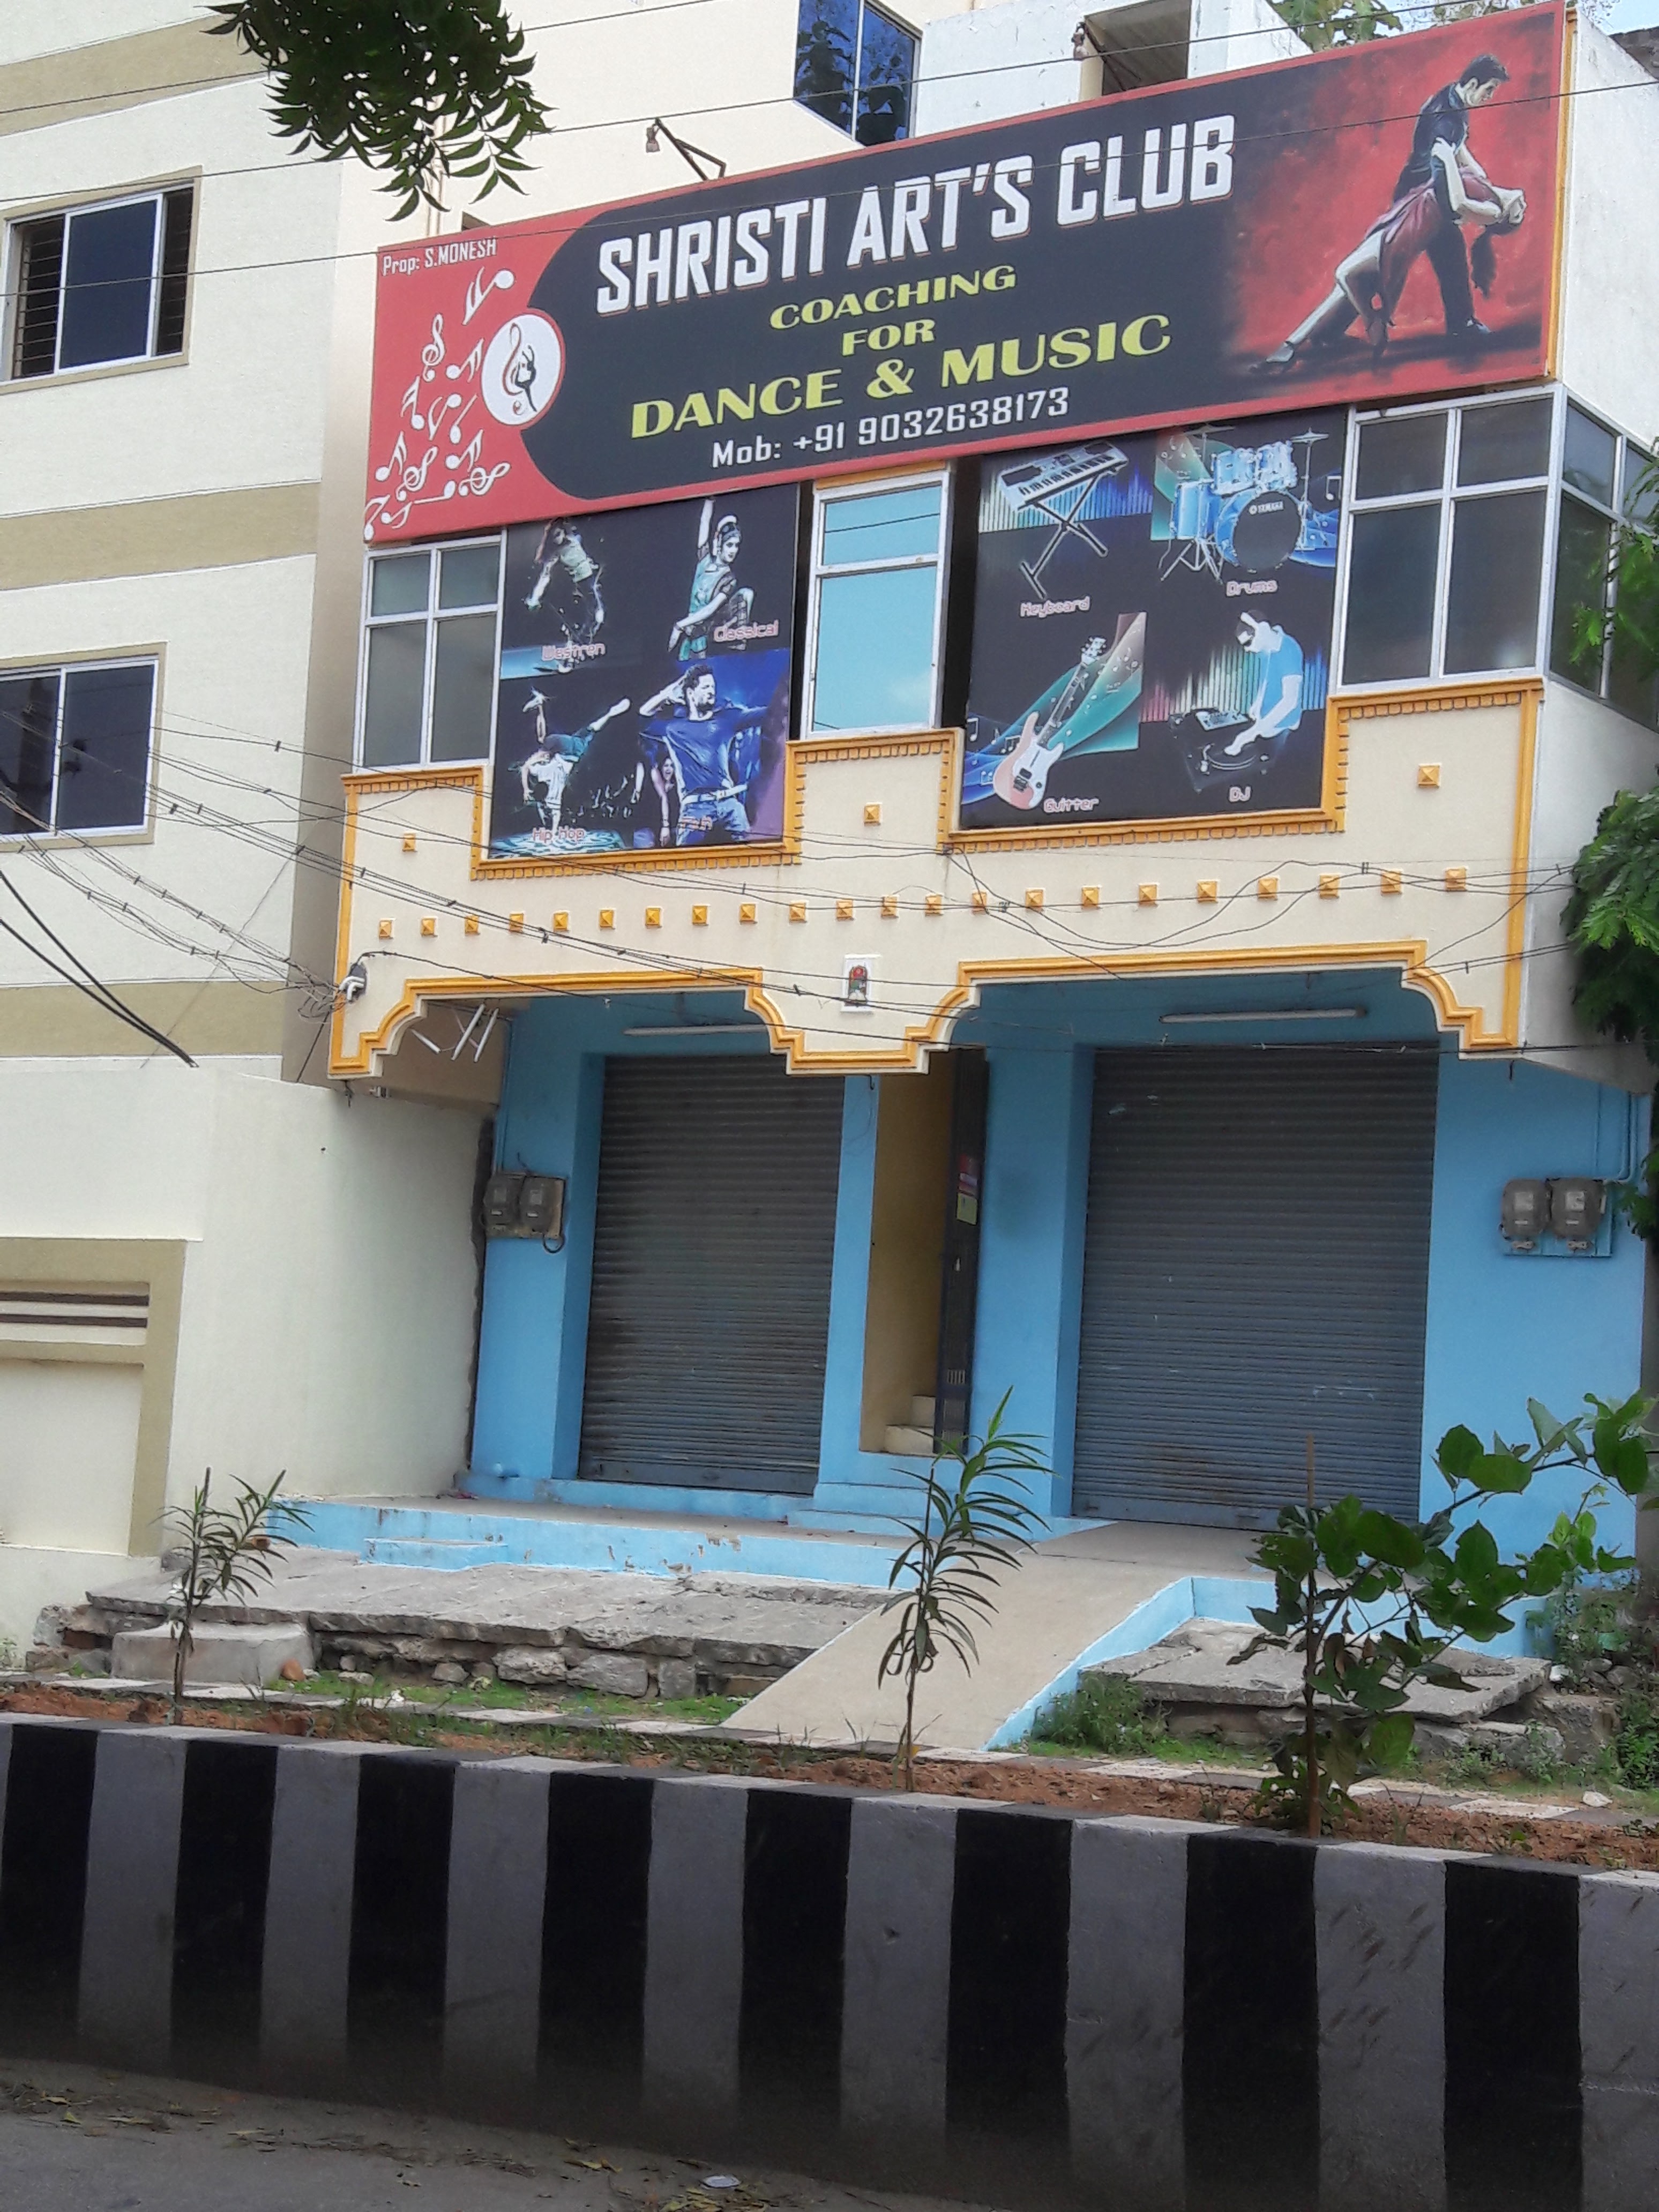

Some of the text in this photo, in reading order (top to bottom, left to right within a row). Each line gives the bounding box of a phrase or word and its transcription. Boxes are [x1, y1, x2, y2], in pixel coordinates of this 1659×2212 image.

[596, 114, 1235, 315] SHRISTI ART'S CLUB
[383, 238, 497, 276] Prop: S.MONESH
[769, 265, 1017, 330] COACHING
[841, 318, 936, 356] FOR
[630, 313, 1171, 439] DANCE & MUSIC
[712, 386, 1069, 468] Mob: +91 9032638173
[1020, 596, 1090, 618] Keyboard
[1226, 580, 1278, 596] Drums
[1229, 786, 1251, 802] DJ
